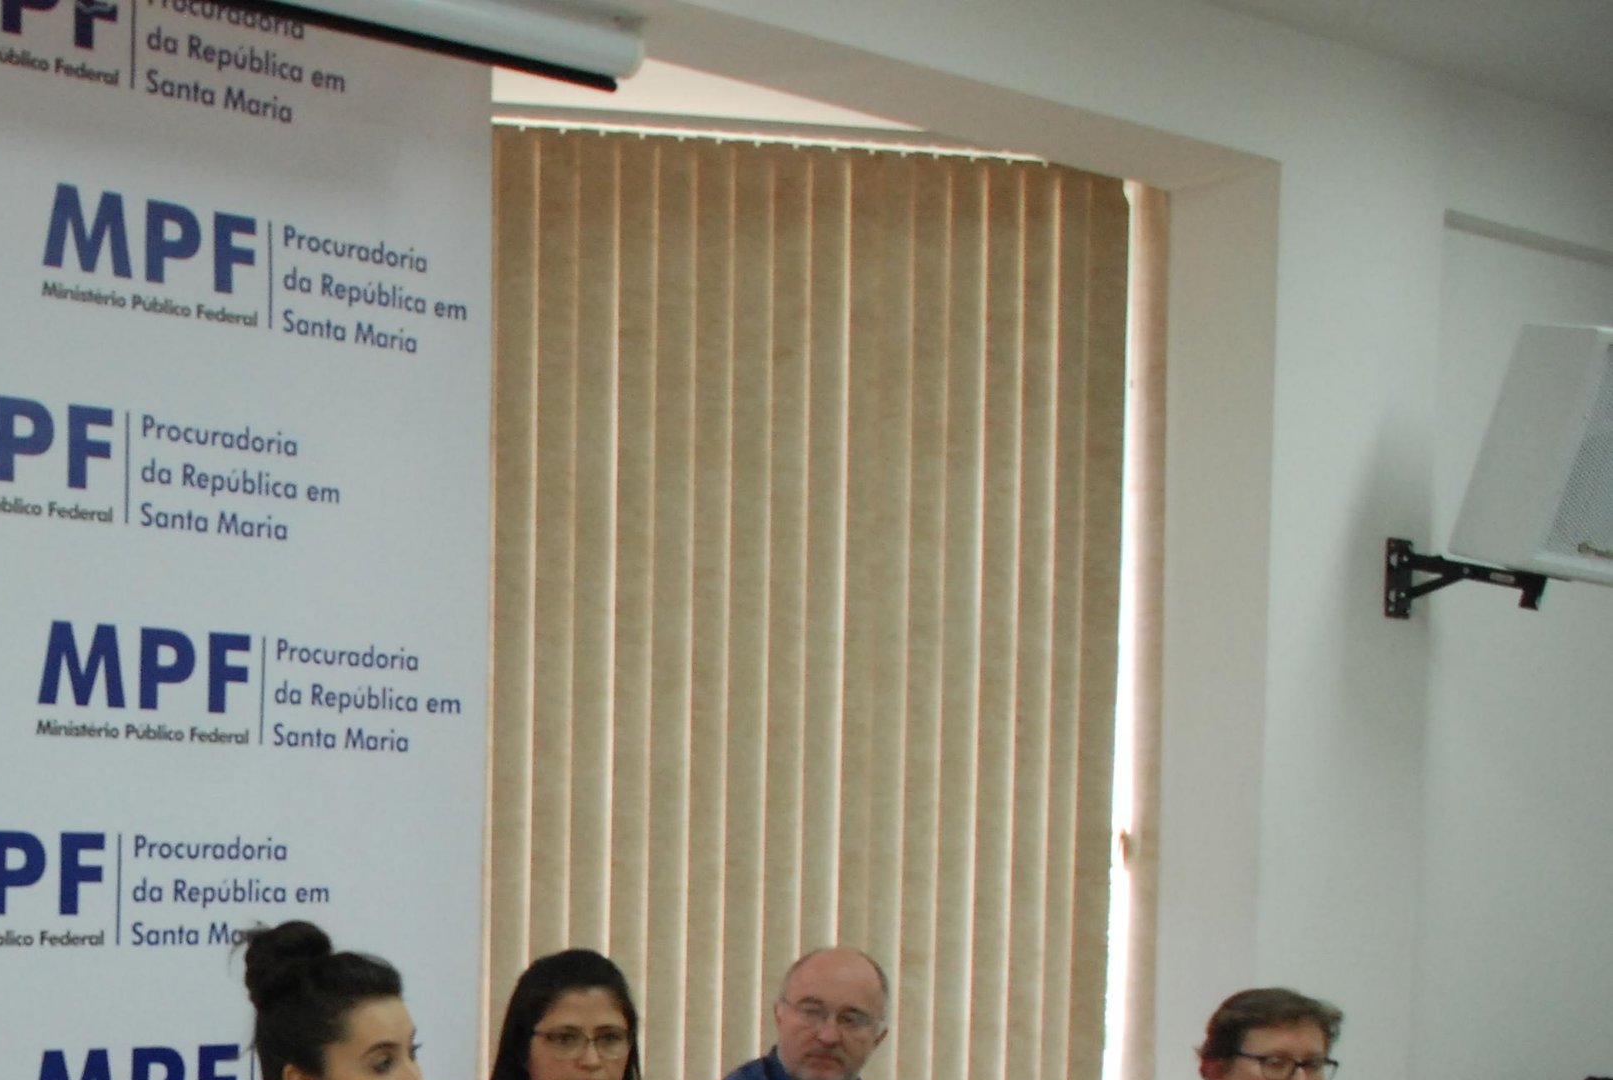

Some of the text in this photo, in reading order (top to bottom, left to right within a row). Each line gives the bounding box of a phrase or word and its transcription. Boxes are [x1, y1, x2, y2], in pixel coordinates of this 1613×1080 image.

[147, 0, 305, 40] rocuradoria
[55, 57, 119, 86] Federal
[146, 25, 178, 54] da
[187, 34, 303, 83] República
[311, 69, 346, 92] em
[146, 69, 292, 124] Santa Maria
[43, 182, 257, 294] MPF
[284, 226, 428, 275] Procuradoria
[42, 281, 257, 328] Ministério Público Federal
[283, 268, 467, 322] da República em
[282, 310, 417, 355] Santa Maria
[142, 415, 298, 458] Procuradoria
[141, 459, 340, 504] da República em
[47, 502, 114, 524] Federal
[140, 502, 288, 541] Santa Maria
[37, 621, 251, 714] MPF
[276, 639, 419, 672] Procuradoria
[275, 681, 461, 717] da República em
[36, 720, 249, 745] Ministério Público Federal
[273, 724, 408, 753] Santa Maria
[134, 835, 288, 862] Procuradoria
[132, 878, 330, 909] da República em
[39, 931, 105, 948] Federal
[132, 921, 200, 946] Santa
